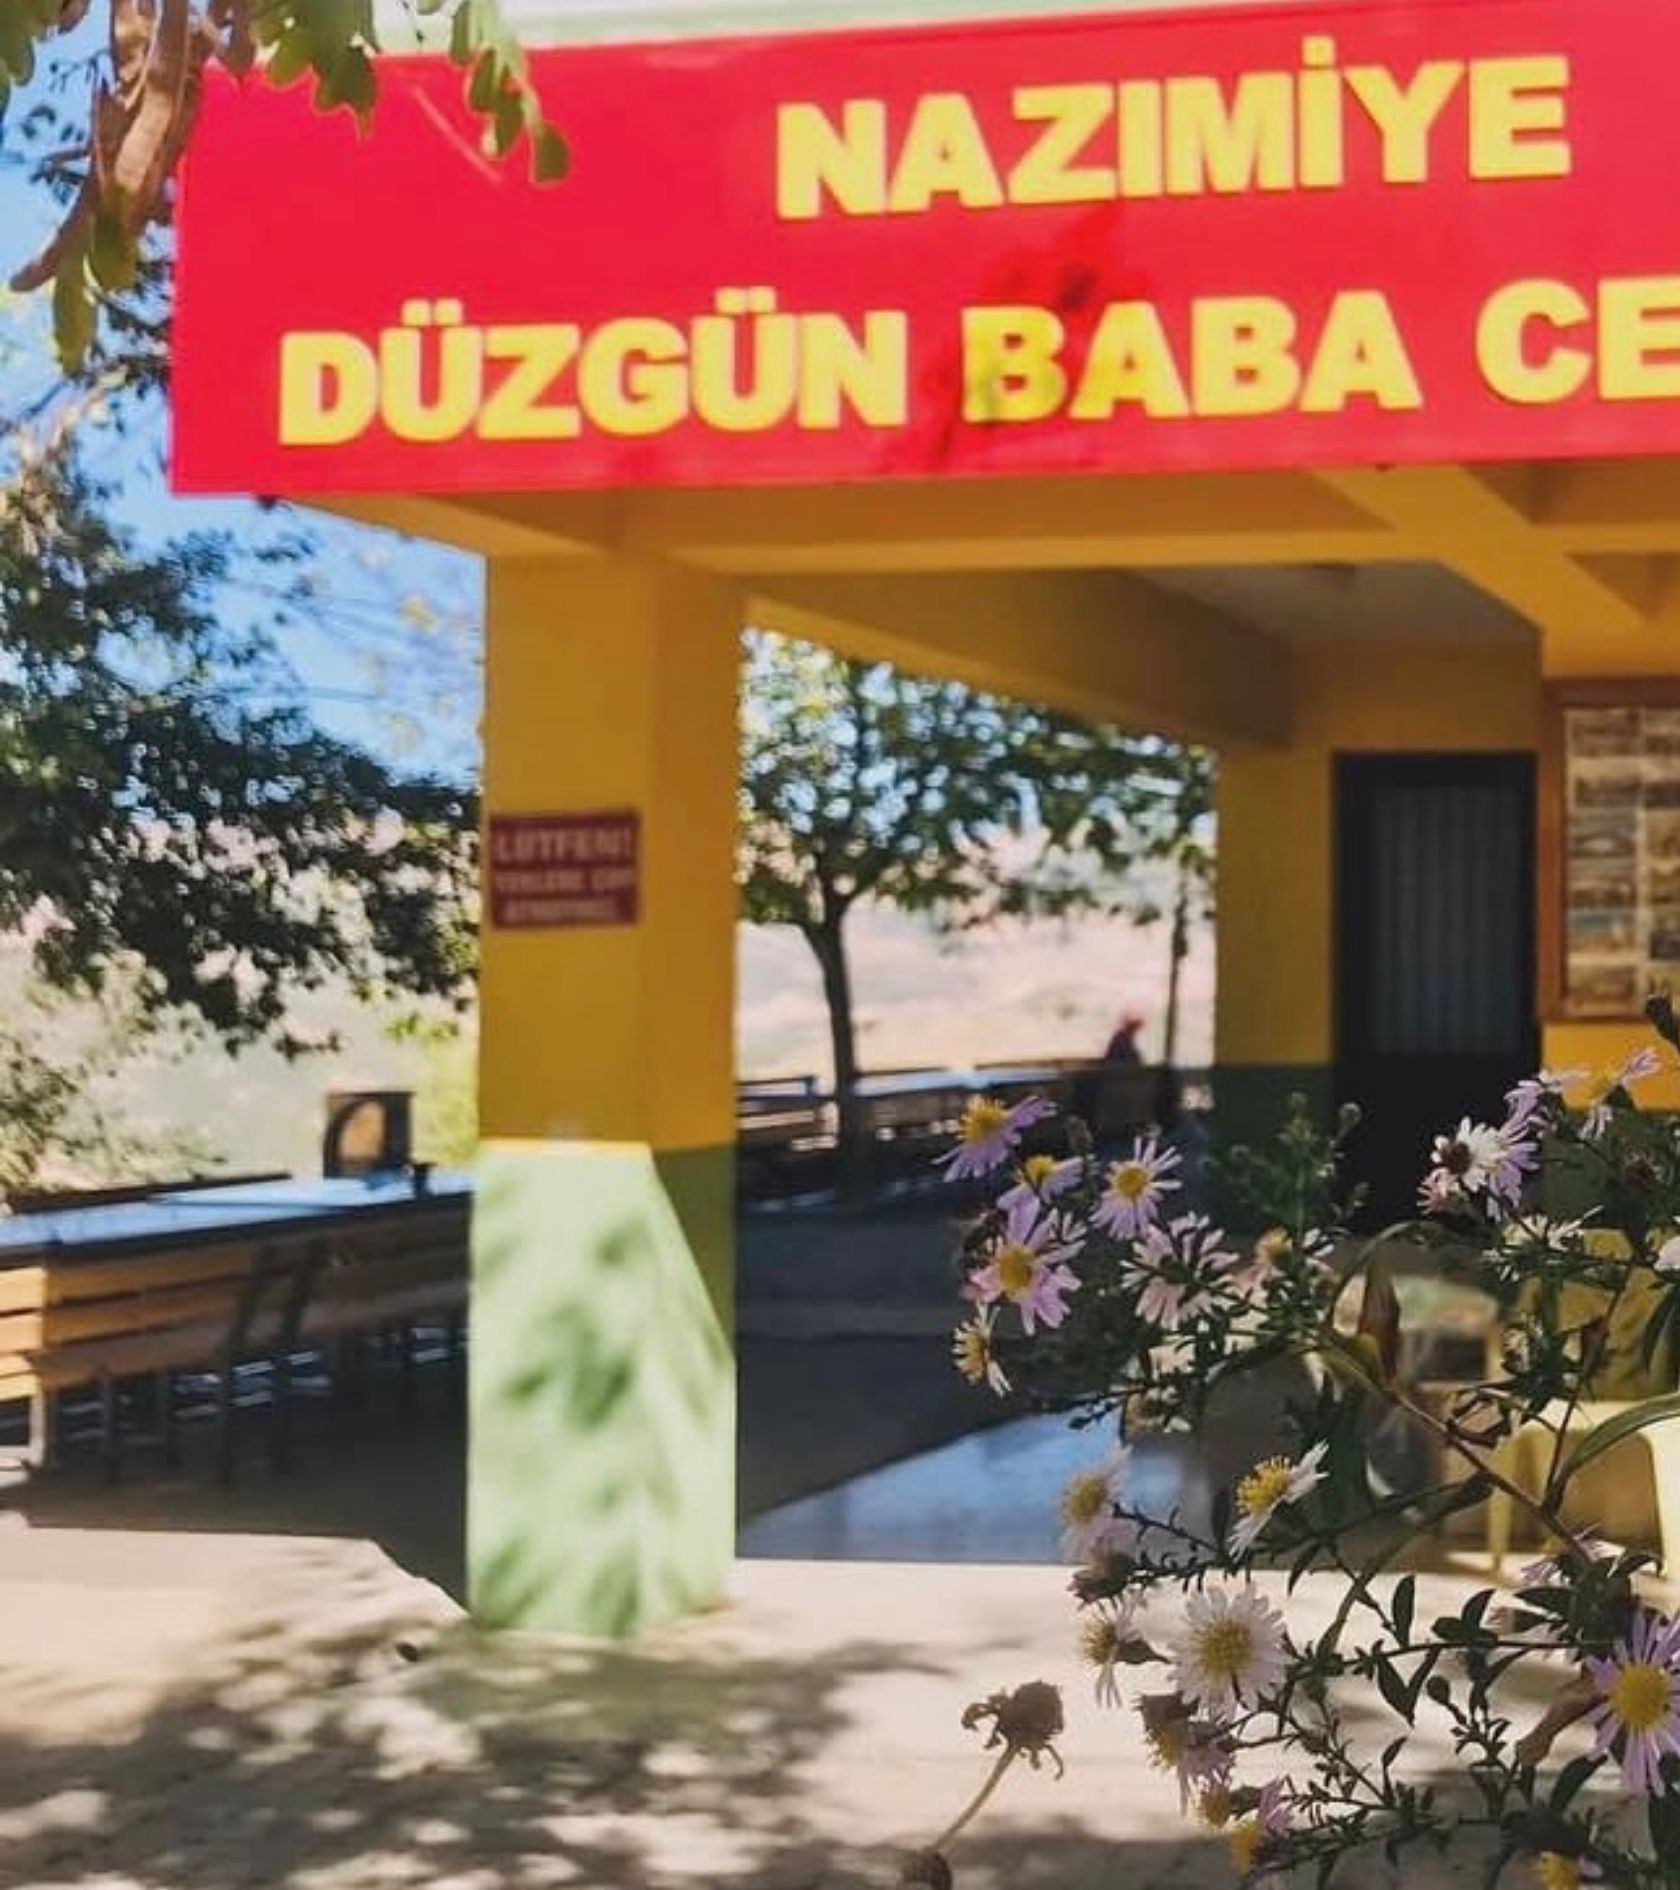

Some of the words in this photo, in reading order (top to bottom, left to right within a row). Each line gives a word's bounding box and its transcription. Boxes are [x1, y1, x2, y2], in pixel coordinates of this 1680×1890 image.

[776, 36, 1571, 219] NAZIMİYE
[278, 286, 908, 446] DÜZGÜN
[961, 290, 1424, 424] BABA
